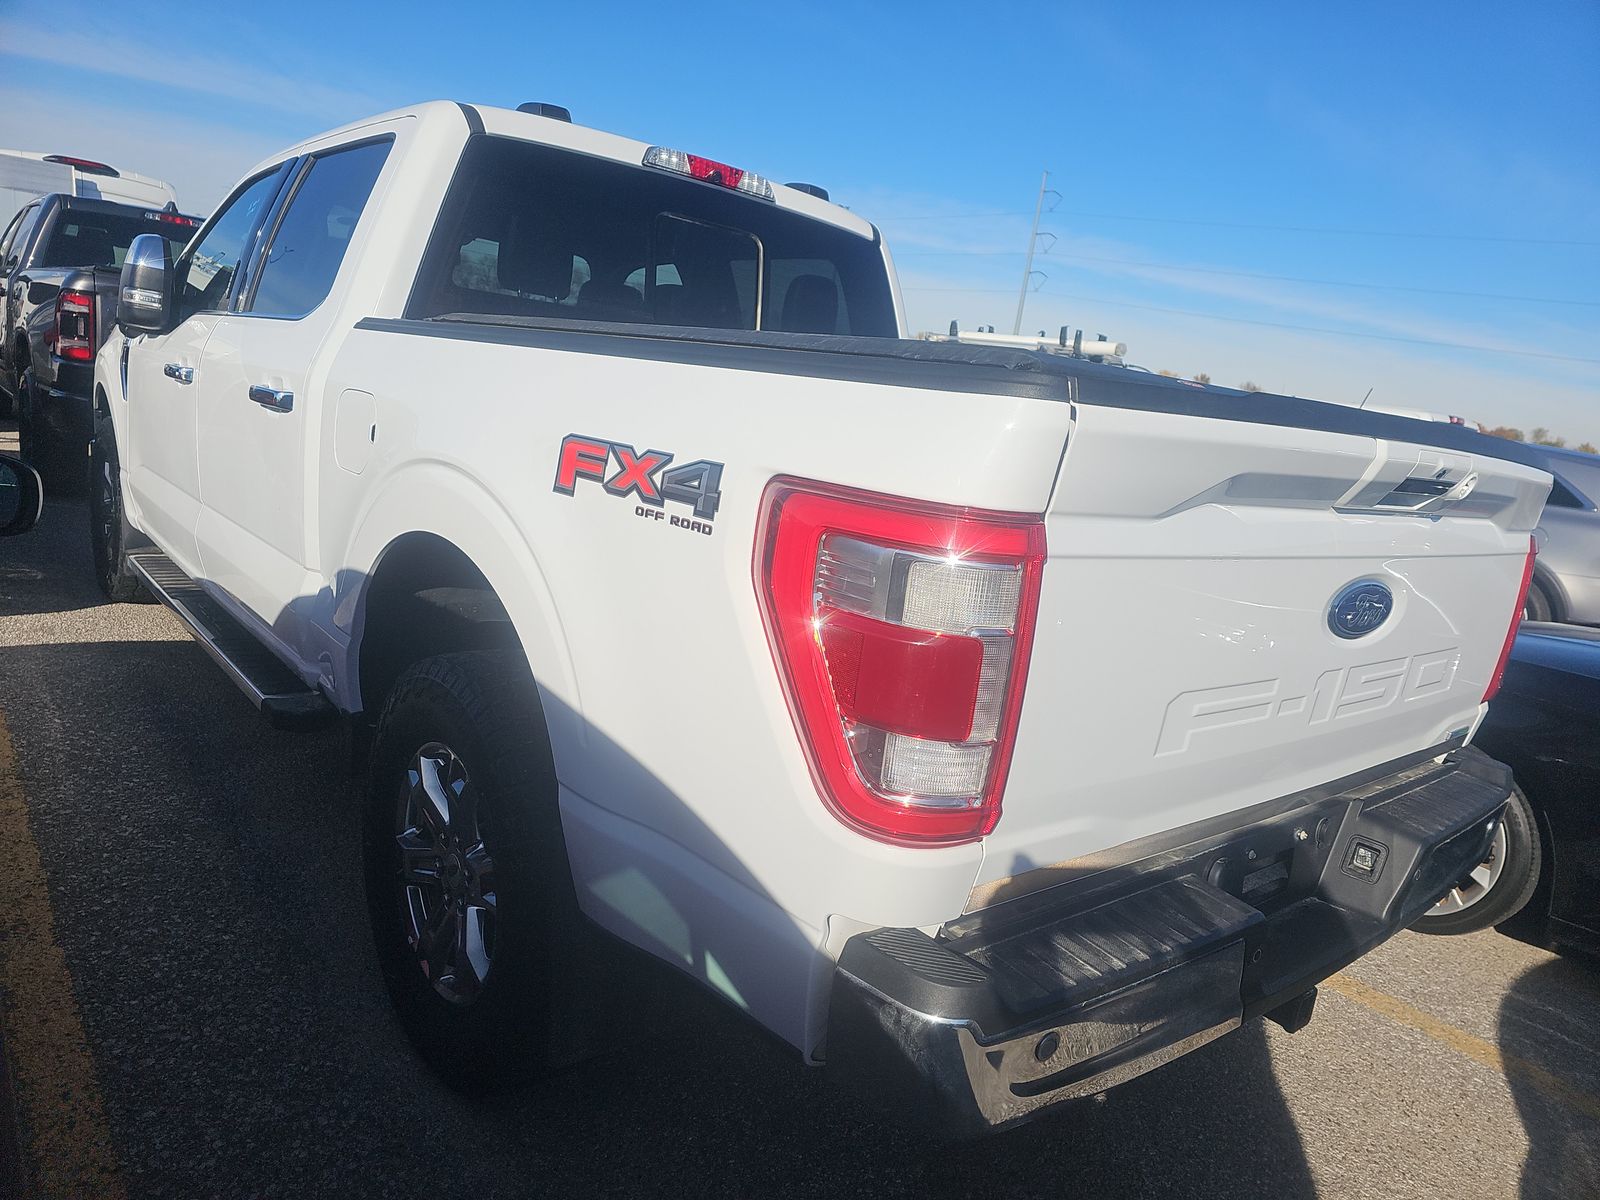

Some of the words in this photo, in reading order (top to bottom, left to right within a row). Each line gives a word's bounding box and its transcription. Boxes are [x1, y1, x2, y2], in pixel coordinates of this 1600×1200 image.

[553, 433, 725, 521] FX4
[634, 505, 665, 521] OFF
[669, 514, 713, 536] ROAD
[1339, 592, 1388, 629] Ford
[1153, 646, 1459, 759] F-150
